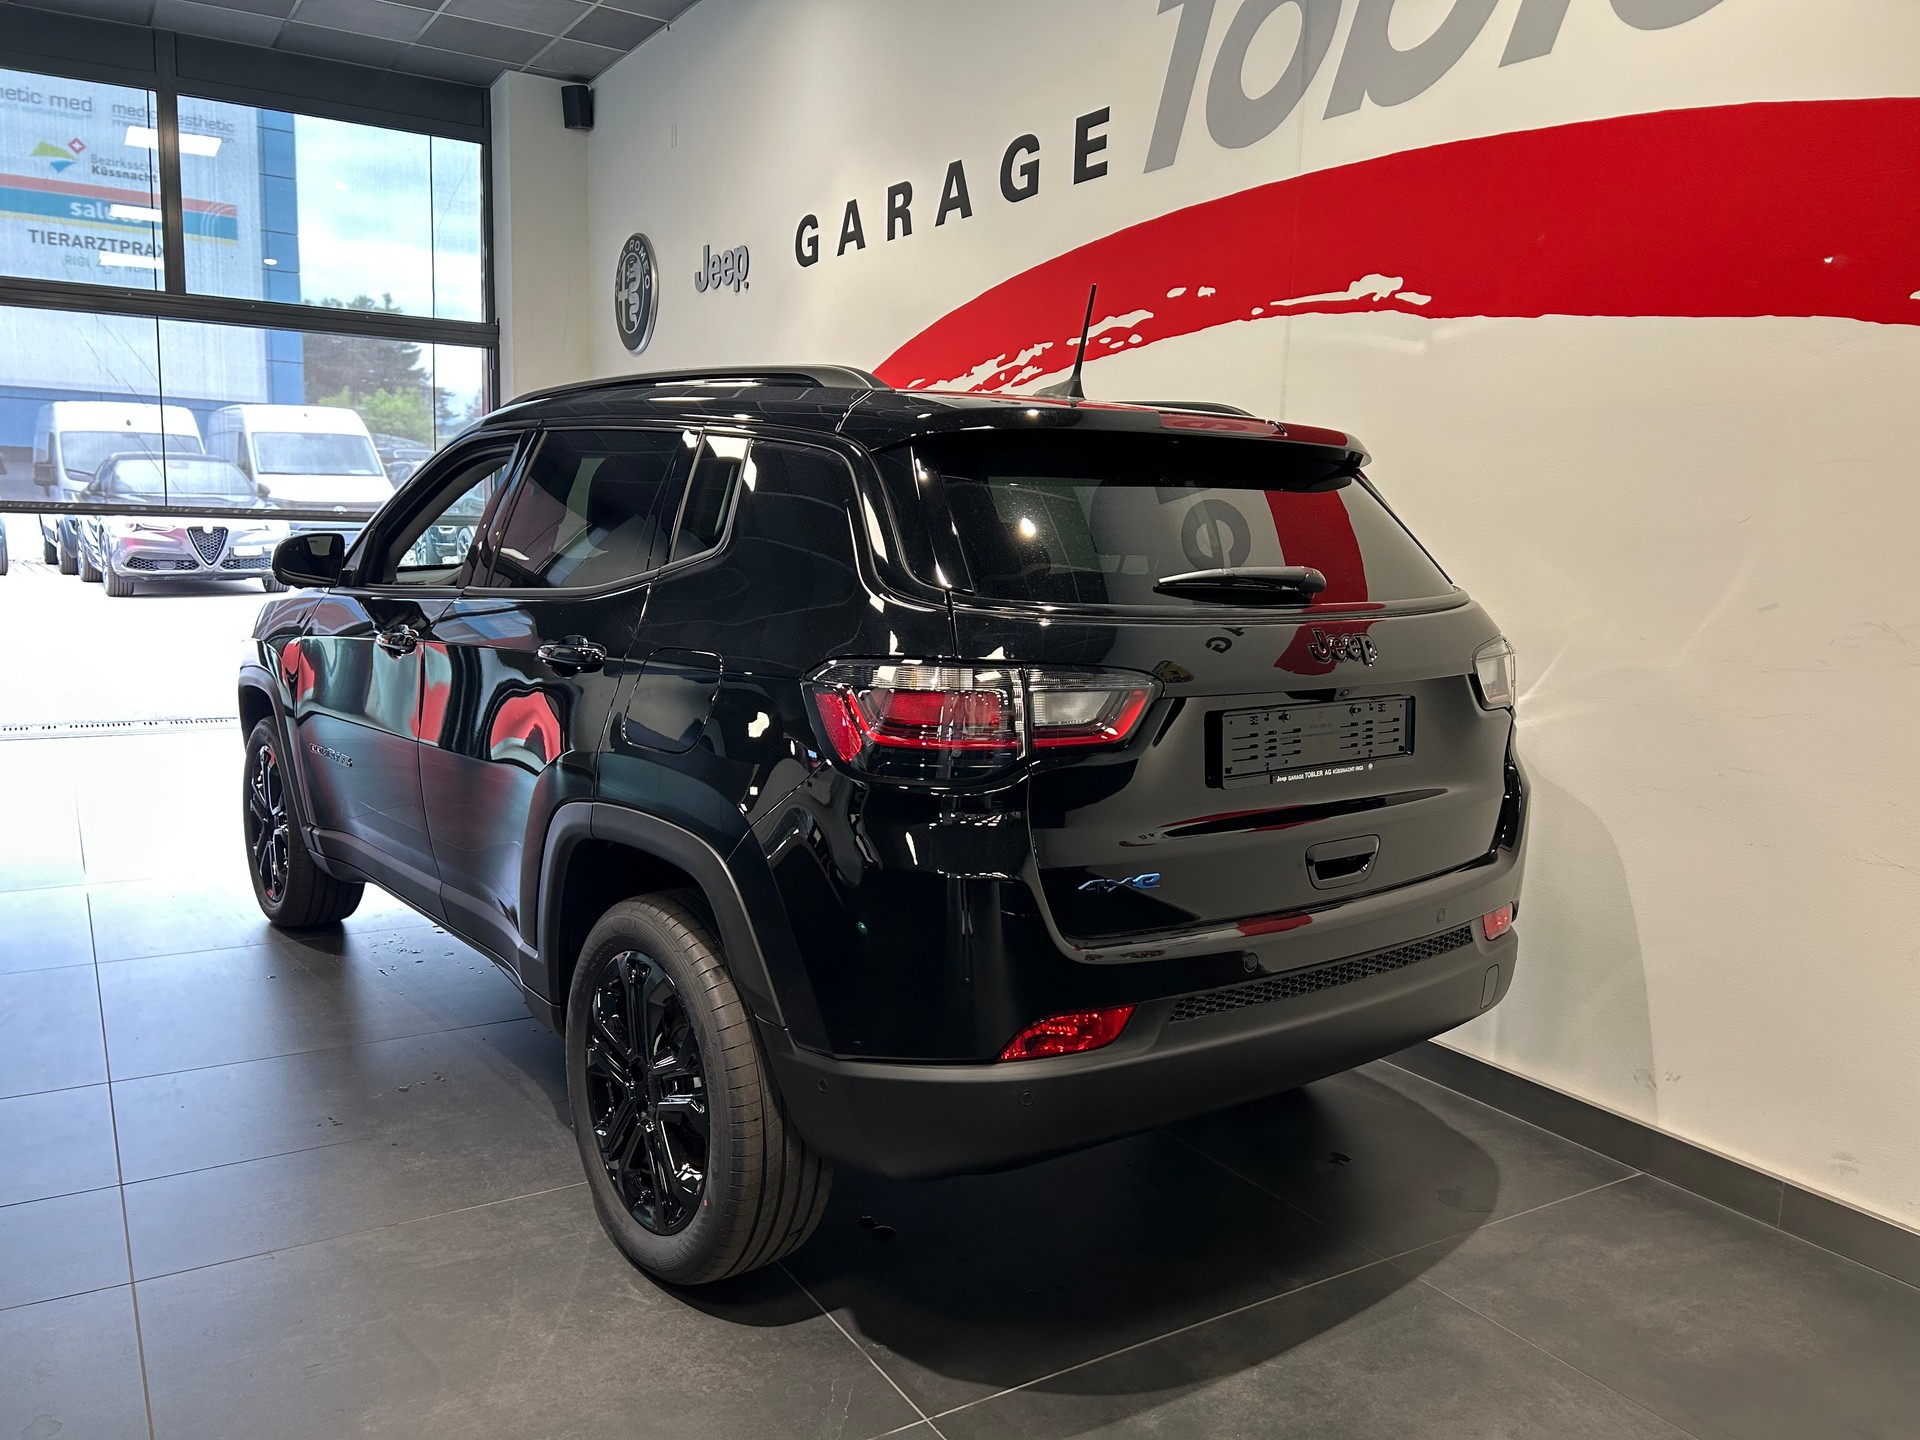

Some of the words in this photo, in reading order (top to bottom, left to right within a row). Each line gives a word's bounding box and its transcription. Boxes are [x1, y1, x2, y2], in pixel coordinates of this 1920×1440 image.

[49, 95, 93, 112] med
[795, 106, 1109, 267] GARAGE
[695, 245, 749, 292] Jeep
[1307, 628, 1378, 667] Jeep
[1304, 770, 1323, 779] TOBLER
